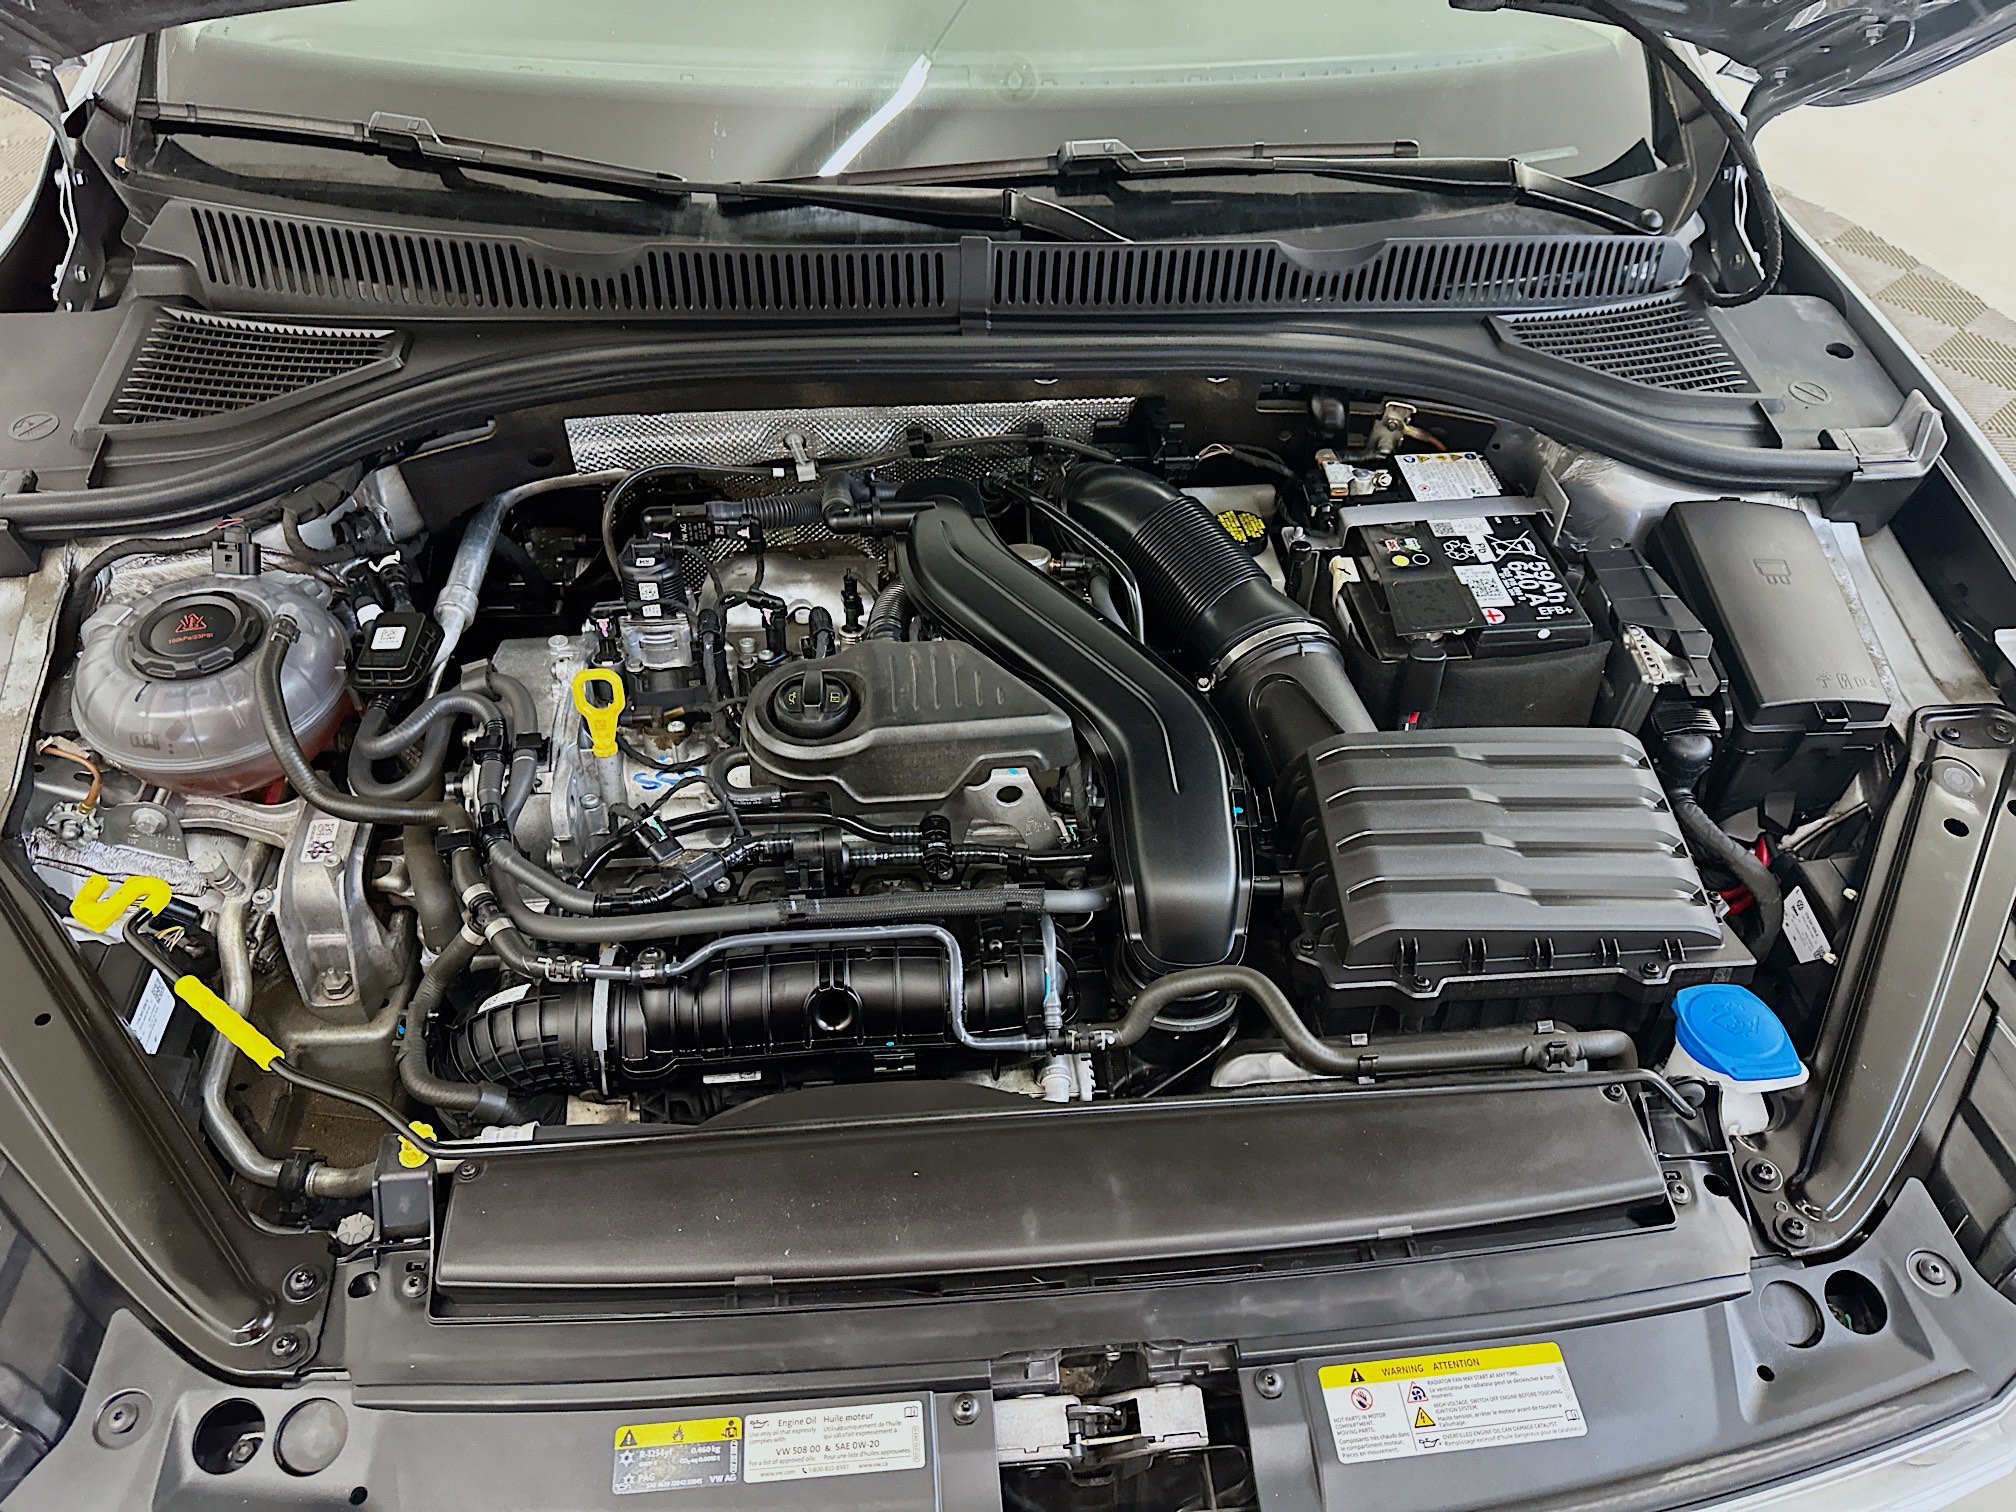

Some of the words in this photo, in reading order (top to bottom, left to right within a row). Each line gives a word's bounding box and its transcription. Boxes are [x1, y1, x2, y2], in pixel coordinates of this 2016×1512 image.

[1507, 560, 1541, 590] 640
[1528, 561, 1568, 604] 59Ah
[1381, 1364, 1424, 1376] WARNING
[1432, 1358, 1480, 1371] ATTENTION
[1427, 1377, 1452, 1386] RADIATOR
[1538, 1389, 1563, 1397] TOUCHING
[778, 1418, 804, 1428] Engine
[806, 1416, 817, 1425] Oil
[824, 1414, 844, 1423] Huile
[846, 1412, 874, 1421] moteur
[776, 1447, 790, 1456] VW
[792, 1446, 808, 1454] 508
[810, 1444, 820, 1453] 00
[836, 1442, 850, 1450] SAE
[852, 1440, 880, 1450] 0W-20
[638, 1472, 656, 1482] PAG
[709, 1475, 724, 1484] VW
[726, 1474, 738, 1482] AG
